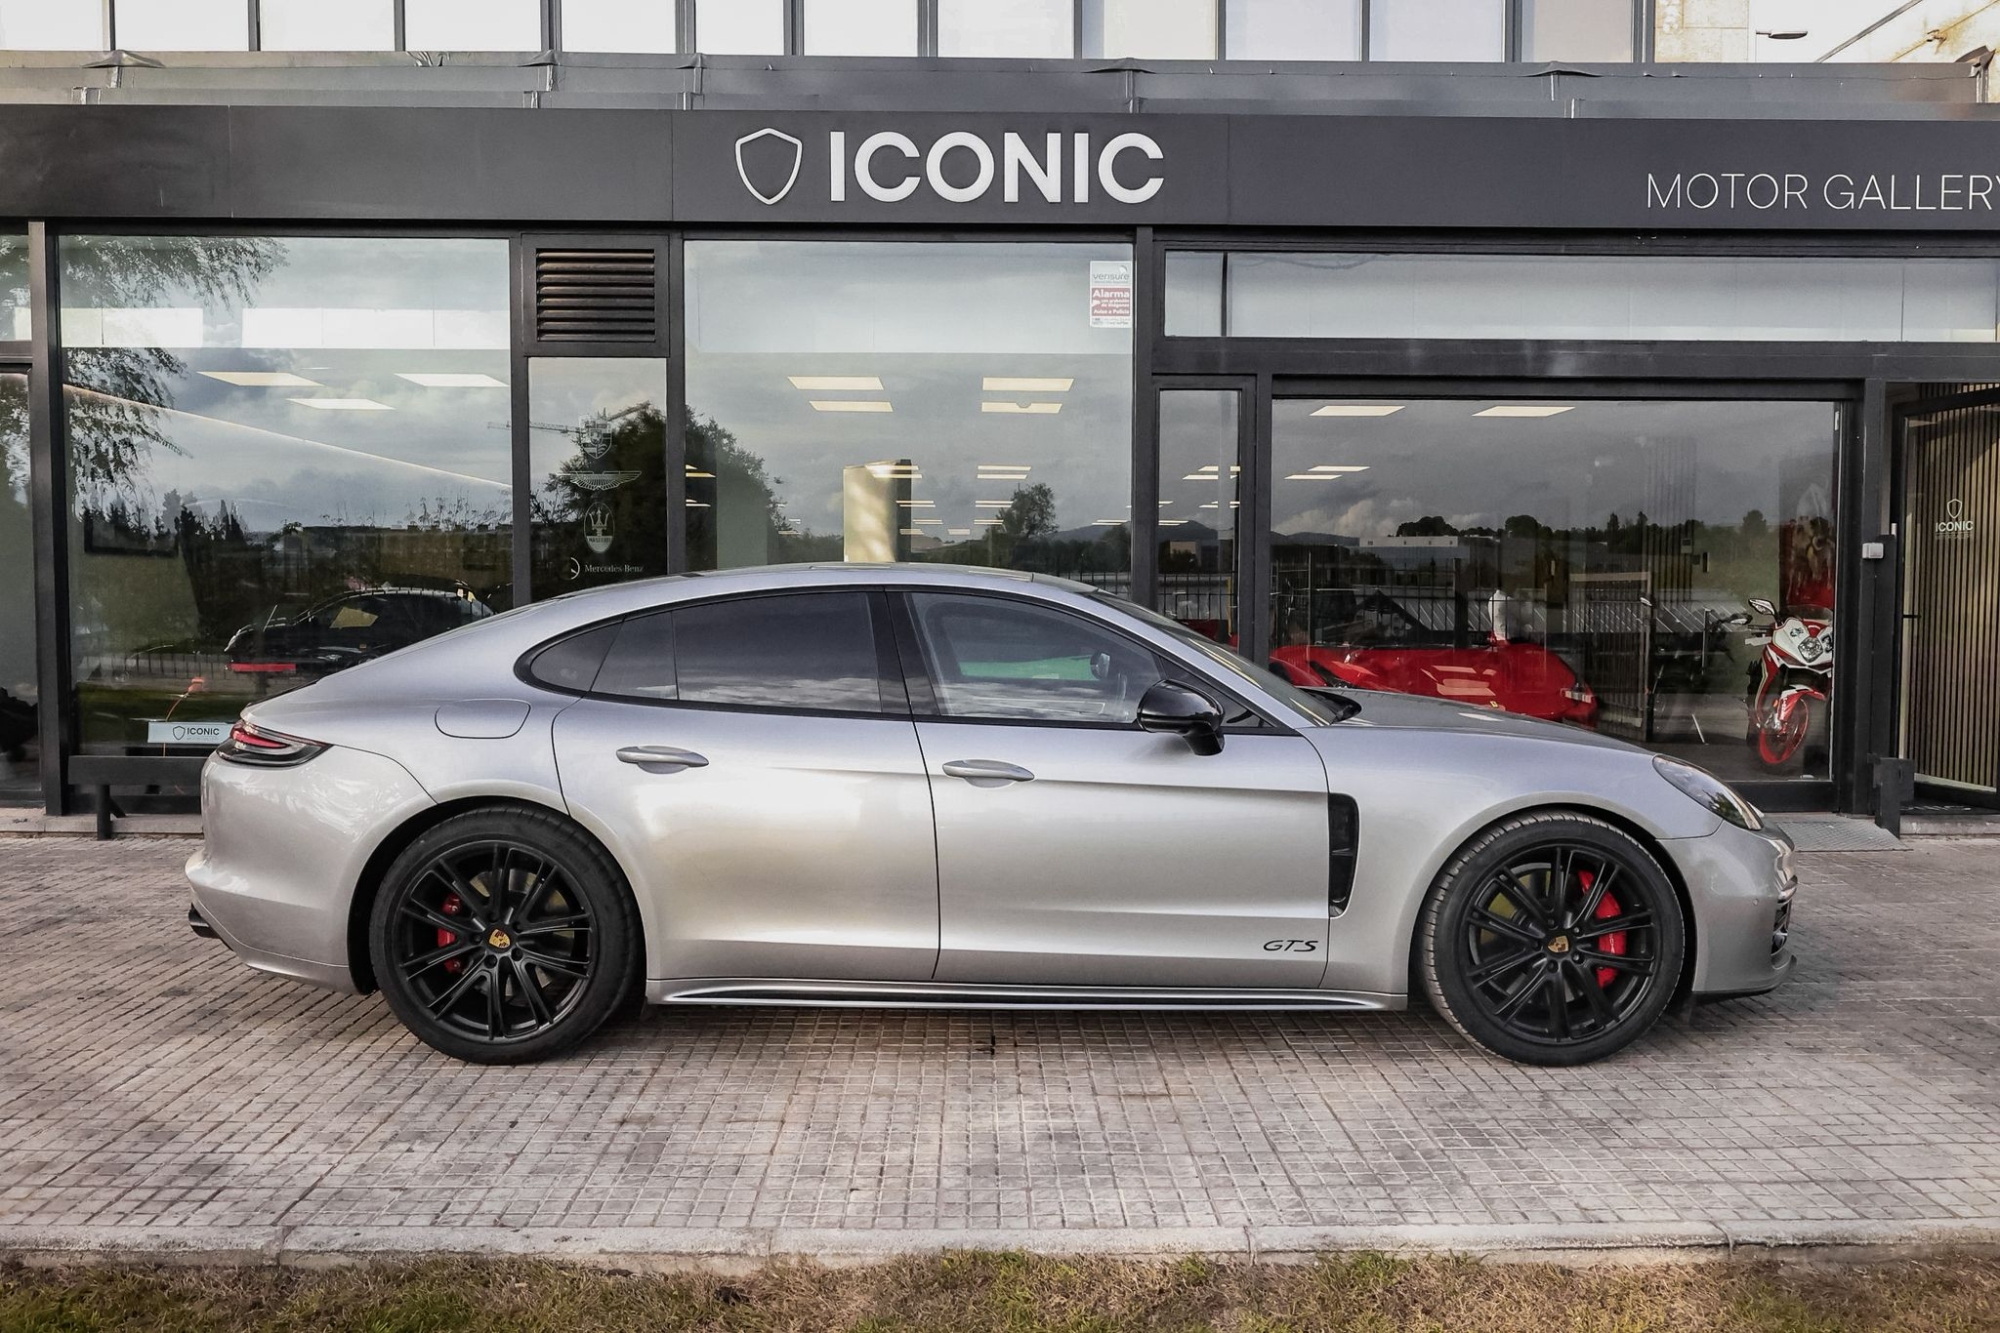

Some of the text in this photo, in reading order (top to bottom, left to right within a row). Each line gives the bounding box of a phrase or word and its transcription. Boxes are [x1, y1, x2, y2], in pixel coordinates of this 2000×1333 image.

[830, 131, 1165, 204] ICONIC
[1647, 172, 1809, 209] MOTOR
[1092, 288, 1130, 298] Alarma
[1935, 520, 1974, 533] ICONIC
[186, 727, 220, 736] ICONIC
[1263, 939, 1319, 953] GTS
